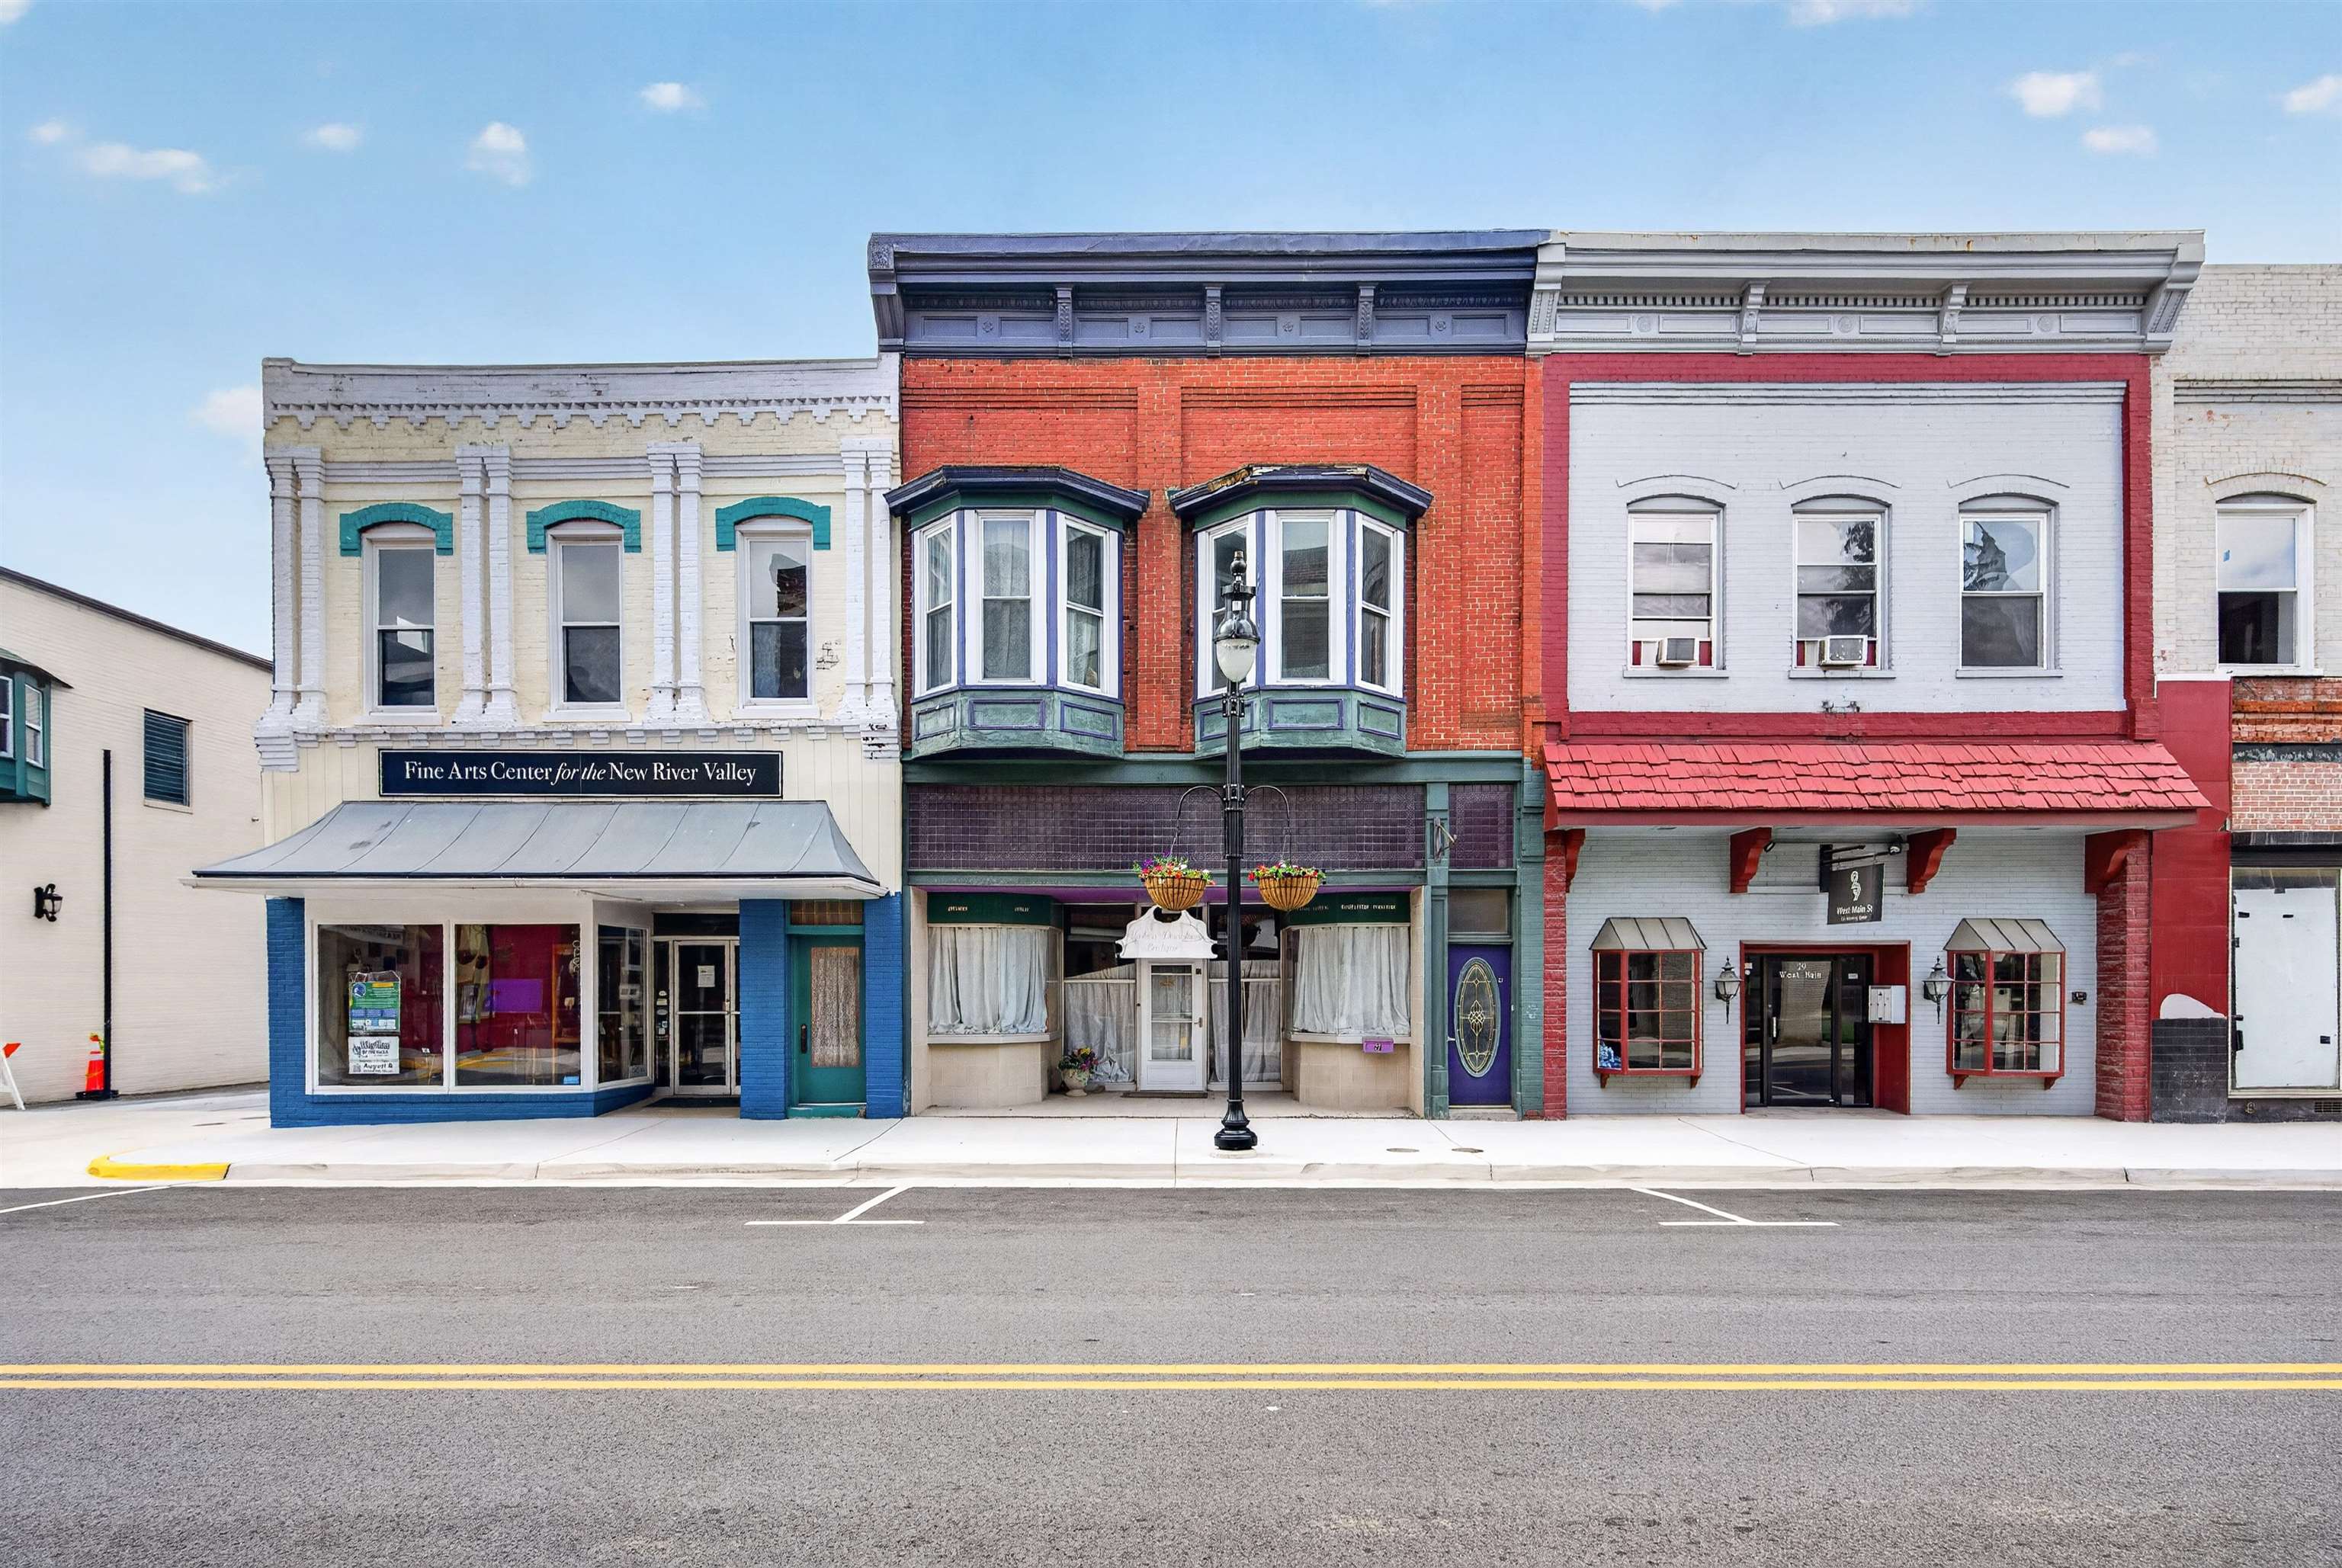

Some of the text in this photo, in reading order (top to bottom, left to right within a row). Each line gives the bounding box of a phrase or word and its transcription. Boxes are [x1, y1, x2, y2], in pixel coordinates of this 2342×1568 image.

[405, 761, 757, 786] Fine Arts Center for the New River Valley
[1837, 906, 1850, 915] West
[1852, 905, 1866, 914] Main
[1805, 971, 1821, 980] Main
